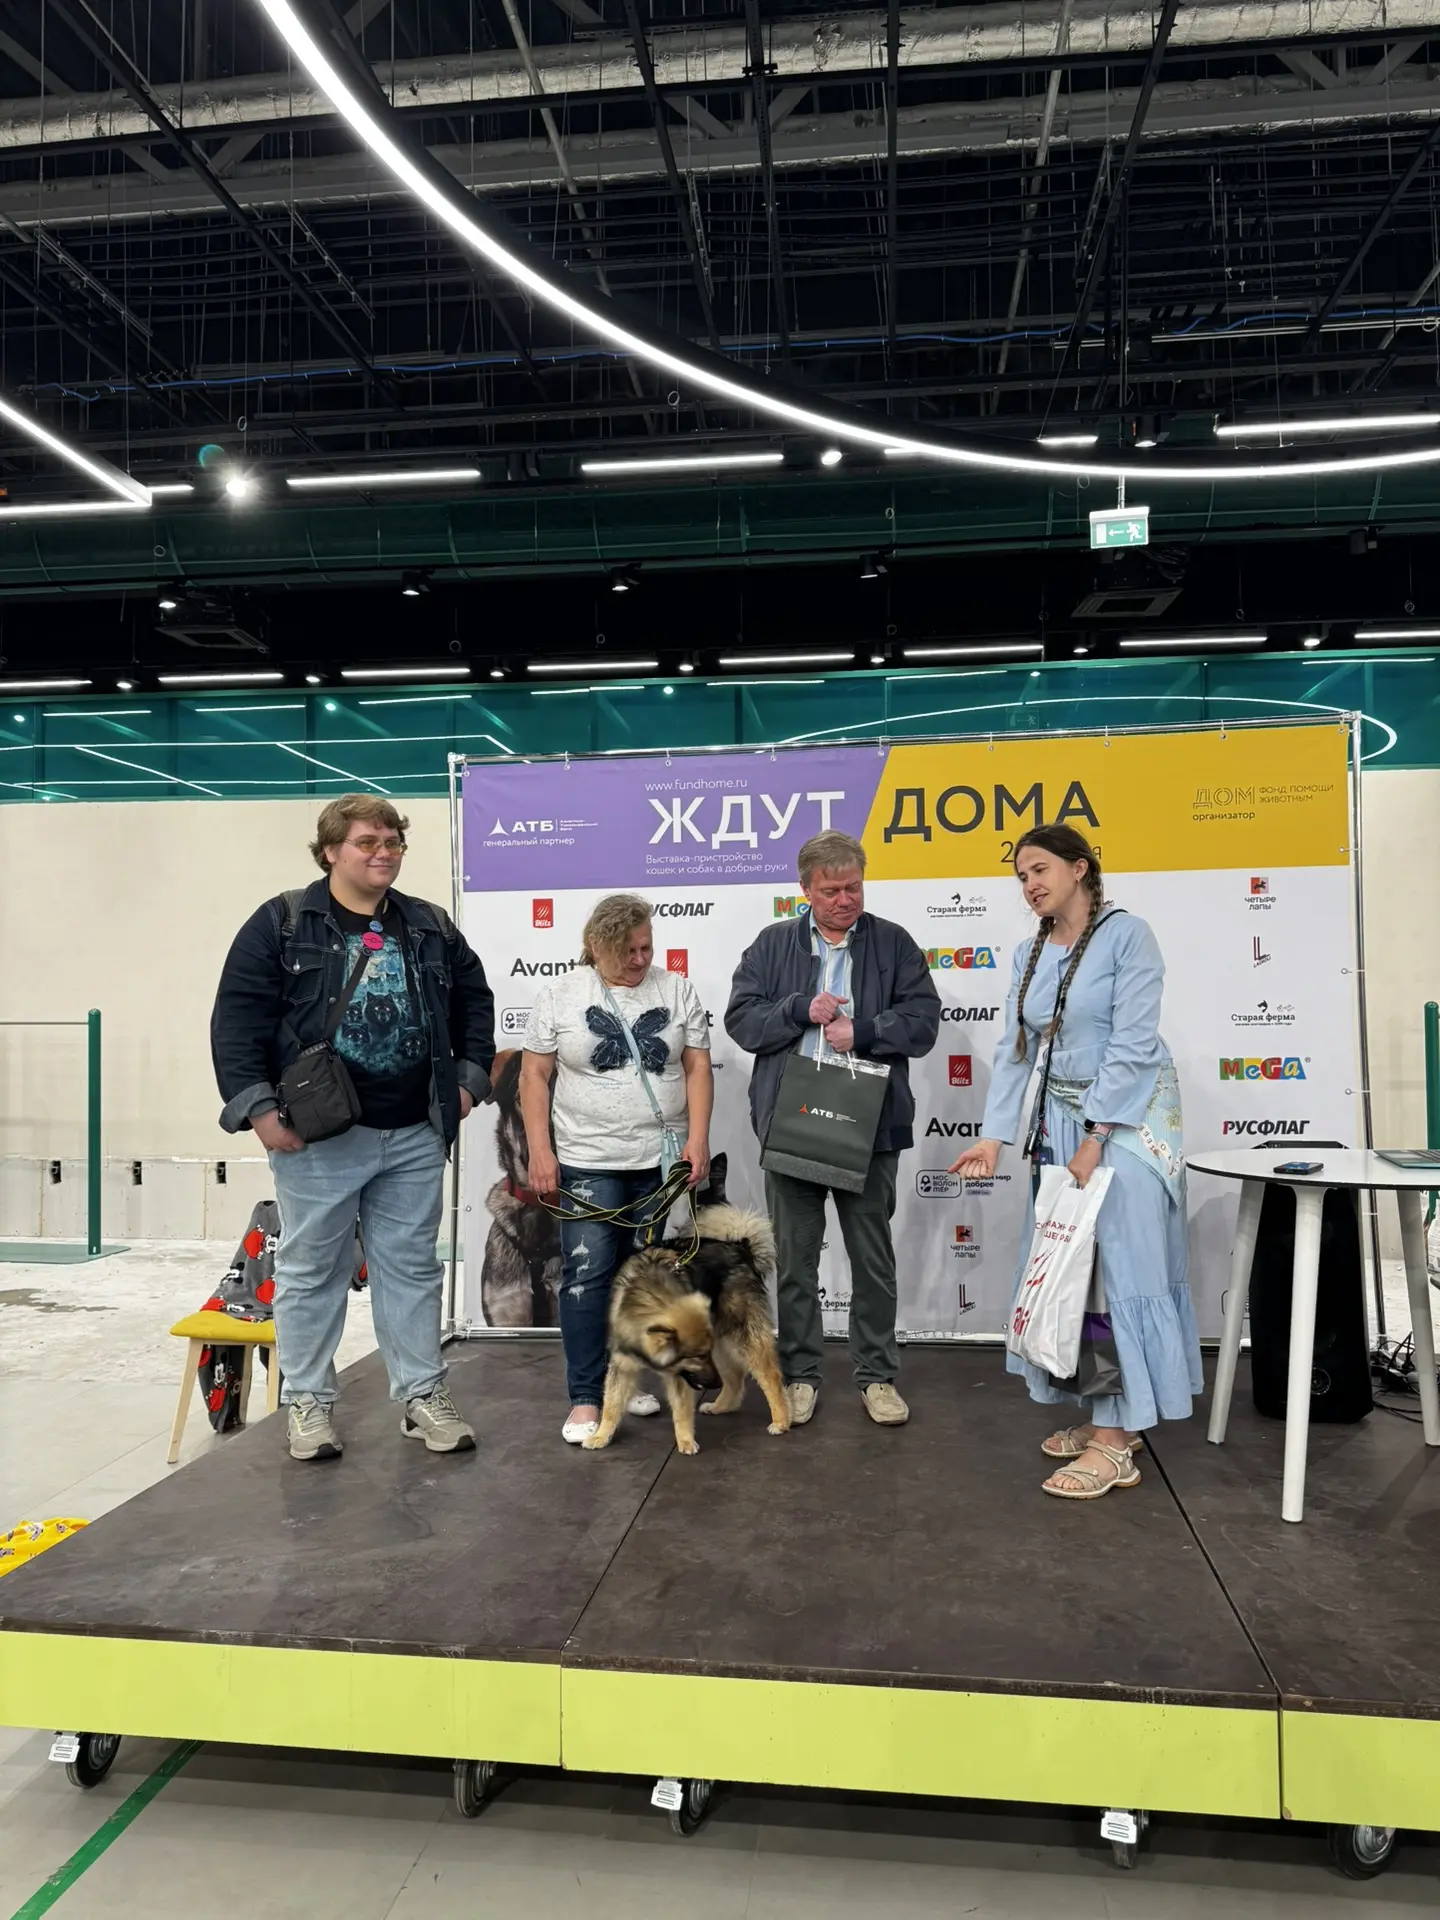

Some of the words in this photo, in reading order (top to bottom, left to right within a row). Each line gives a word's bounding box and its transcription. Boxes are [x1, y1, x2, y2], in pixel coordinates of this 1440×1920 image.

[645, 778, 748, 792] www.fundhome.ru
[1259, 786, 1288, 794] ФОНД
[1290, 784, 1334, 793] ПОМОЩИ
[1193, 786, 1256, 809] ДОМ
[1260, 795, 1313, 804] ЖИВОТНЫМ
[883, 781, 1101, 843] ДОМА
[1192, 811, 1256, 822] организатор
[511, 820, 554, 833] АТБ
[648, 791, 845, 850] ЖДУТ
[483, 837, 538, 848] генеральный
[539, 837, 575, 847] партнер
[646, 852, 763, 864] Выставка-пристройство
[646, 866, 676, 875] кошек
[686, 863, 715, 874] собак
[725, 862, 762, 873] добрые
[764, 862, 788, 873] руки
[651, 902, 715, 917] УСФЛАГ
[926, 906, 957, 914] Старая
[959, 904, 987, 913] ферма
[1248, 903, 1272, 911] лапы
[940, 1007, 1000, 1022] СФЛАГ
[1231, 1013, 1264, 1022] Старая
[1265, 1012, 1296, 1022] ферма
[810, 1107, 834, 1119] АТБ
[1222, 1119, 1310, 1135] РУСФЛАГ
[965, 1180, 994, 1188] добрее
[954, 1251, 977, 1259] лапы
